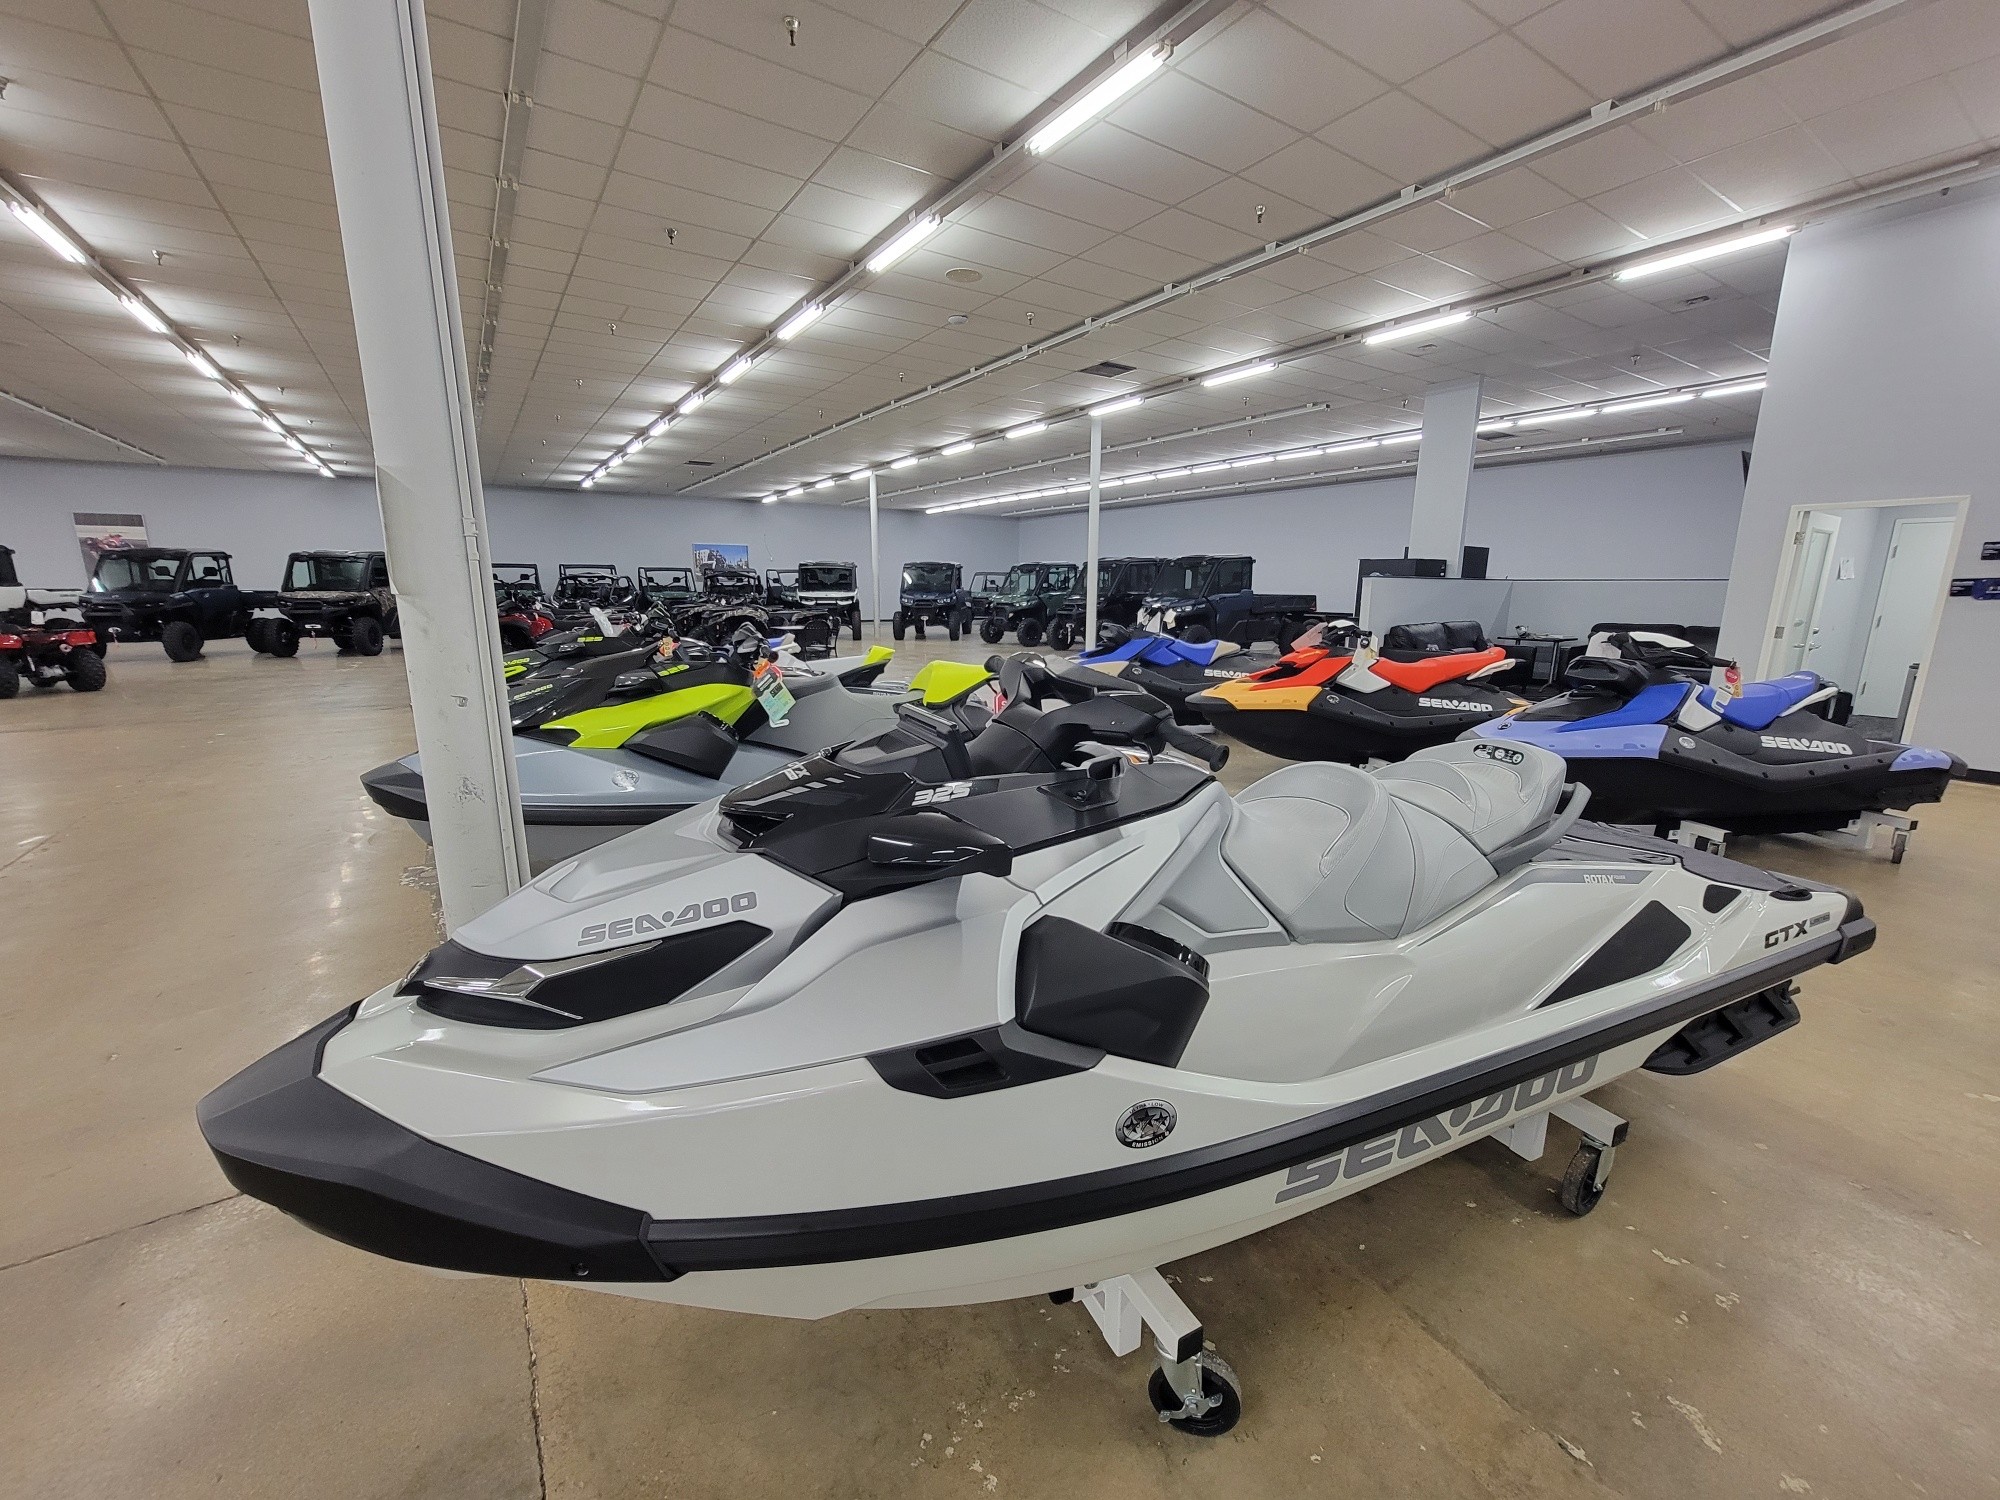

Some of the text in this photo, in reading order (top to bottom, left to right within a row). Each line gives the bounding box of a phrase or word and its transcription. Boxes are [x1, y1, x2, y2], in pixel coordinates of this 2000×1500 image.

[911, 781, 973, 807] 325
[1583, 874, 1615, 885] ROTAX
[1764, 918, 1808, 949] GTX
